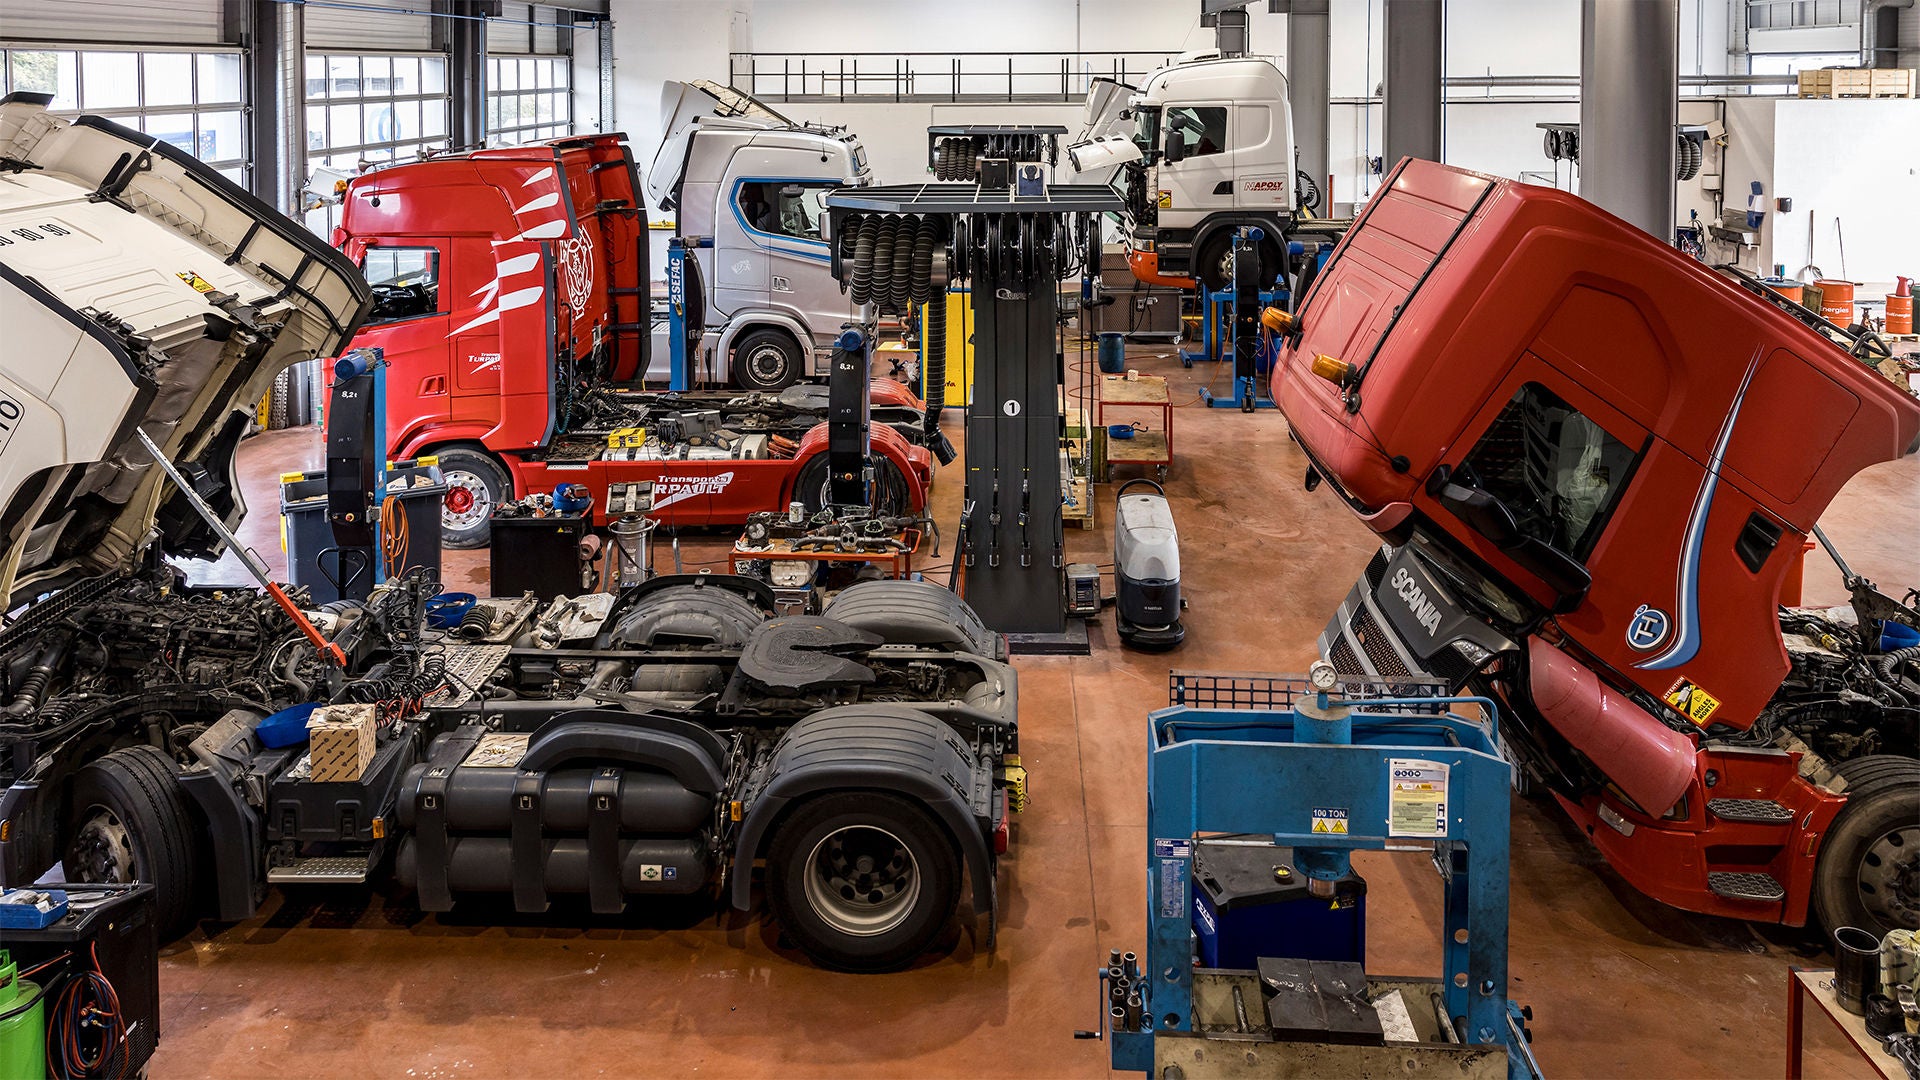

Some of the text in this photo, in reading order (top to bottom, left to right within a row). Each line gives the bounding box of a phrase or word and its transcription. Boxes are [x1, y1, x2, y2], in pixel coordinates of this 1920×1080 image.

[671, 257, 681, 294] SEFAC
[1008, 401, 1016, 414] 1
[1391, 567, 1443, 637] SCANIA
[1663, 675, 1685, 700] ATTENTION
[1692, 697, 1711, 718] ANGLES
[1698, 702, 1715, 720] MORTS
[1313, 809, 1327, 817] 100
